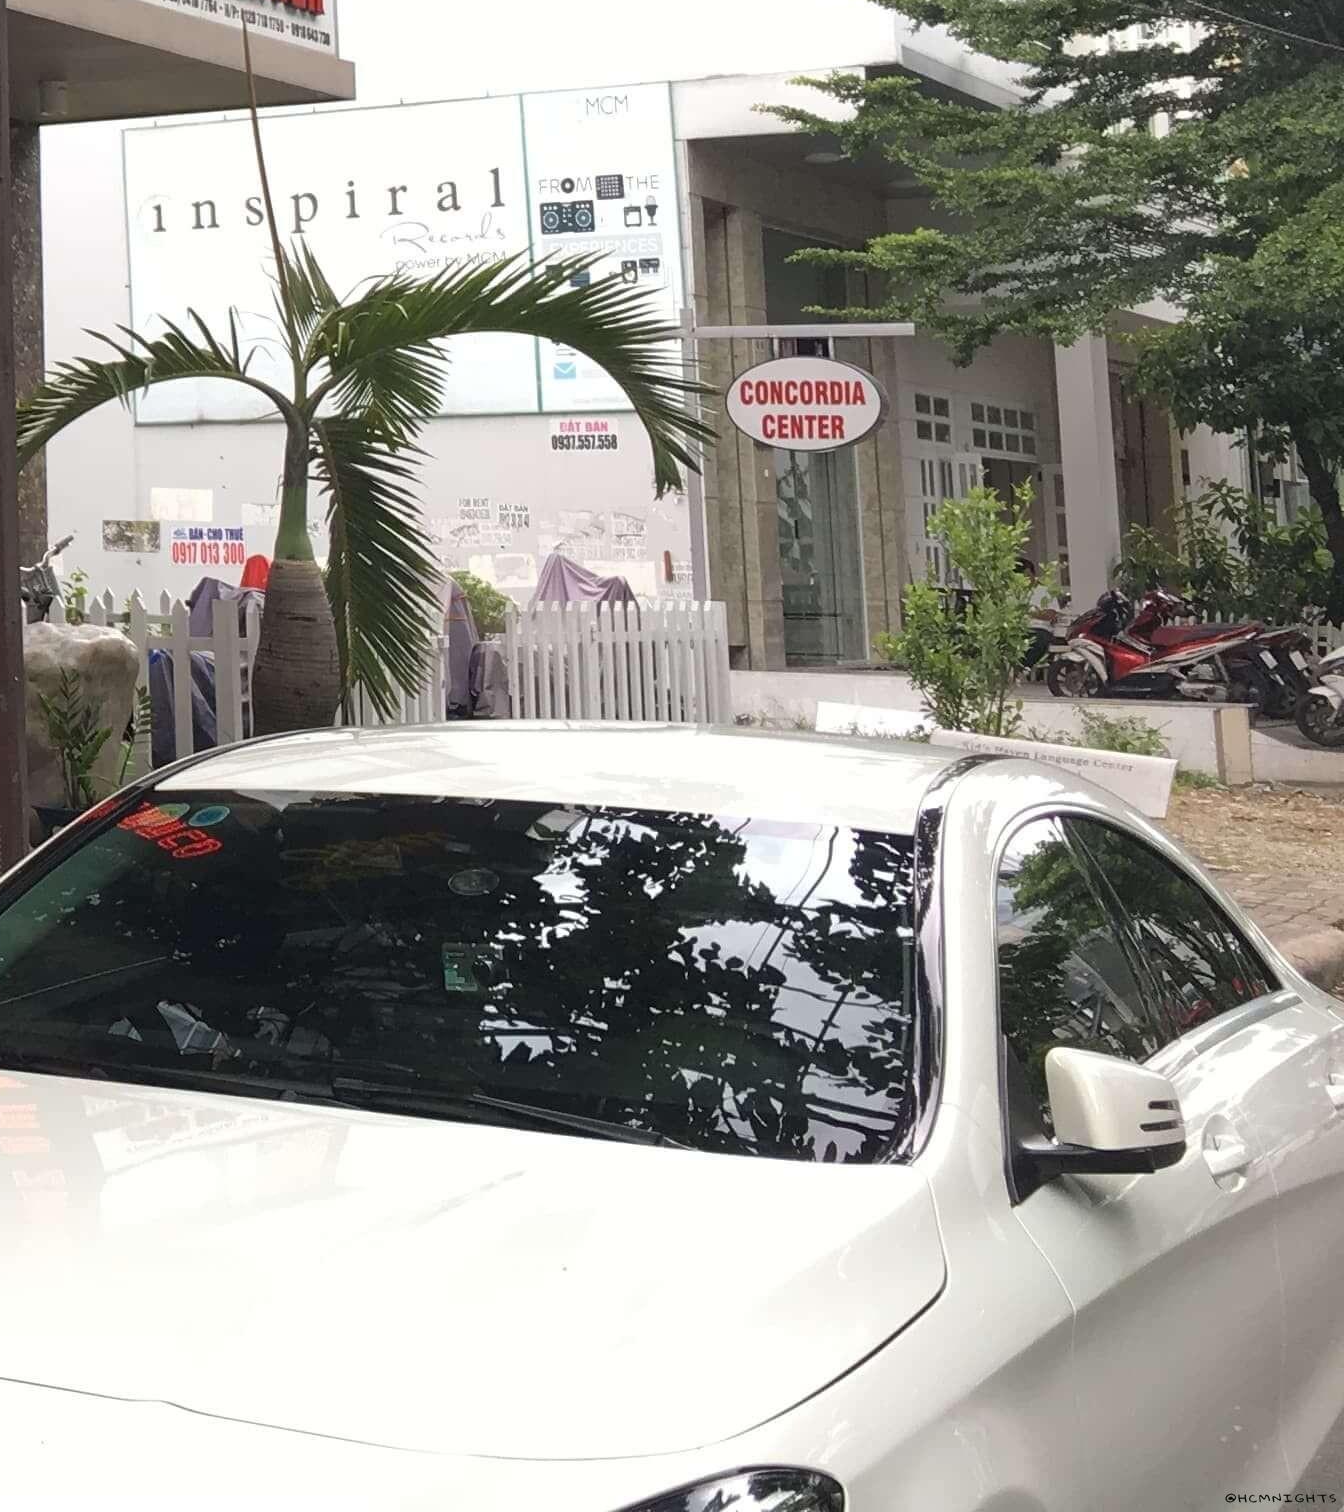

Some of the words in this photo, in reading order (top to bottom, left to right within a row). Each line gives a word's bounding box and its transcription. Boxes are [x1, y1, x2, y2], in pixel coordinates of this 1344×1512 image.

[585, 95, 629, 116] MCM
[625, 173, 661, 191] THE
[152, 167, 506, 235] inspiral
[740, 380, 866, 406] CONCORDIA
[761, 414, 845, 440] CENTER
[172, 542, 197, 565] 0917
[200, 542, 220, 565] 013
[223, 542, 245, 565] 300
